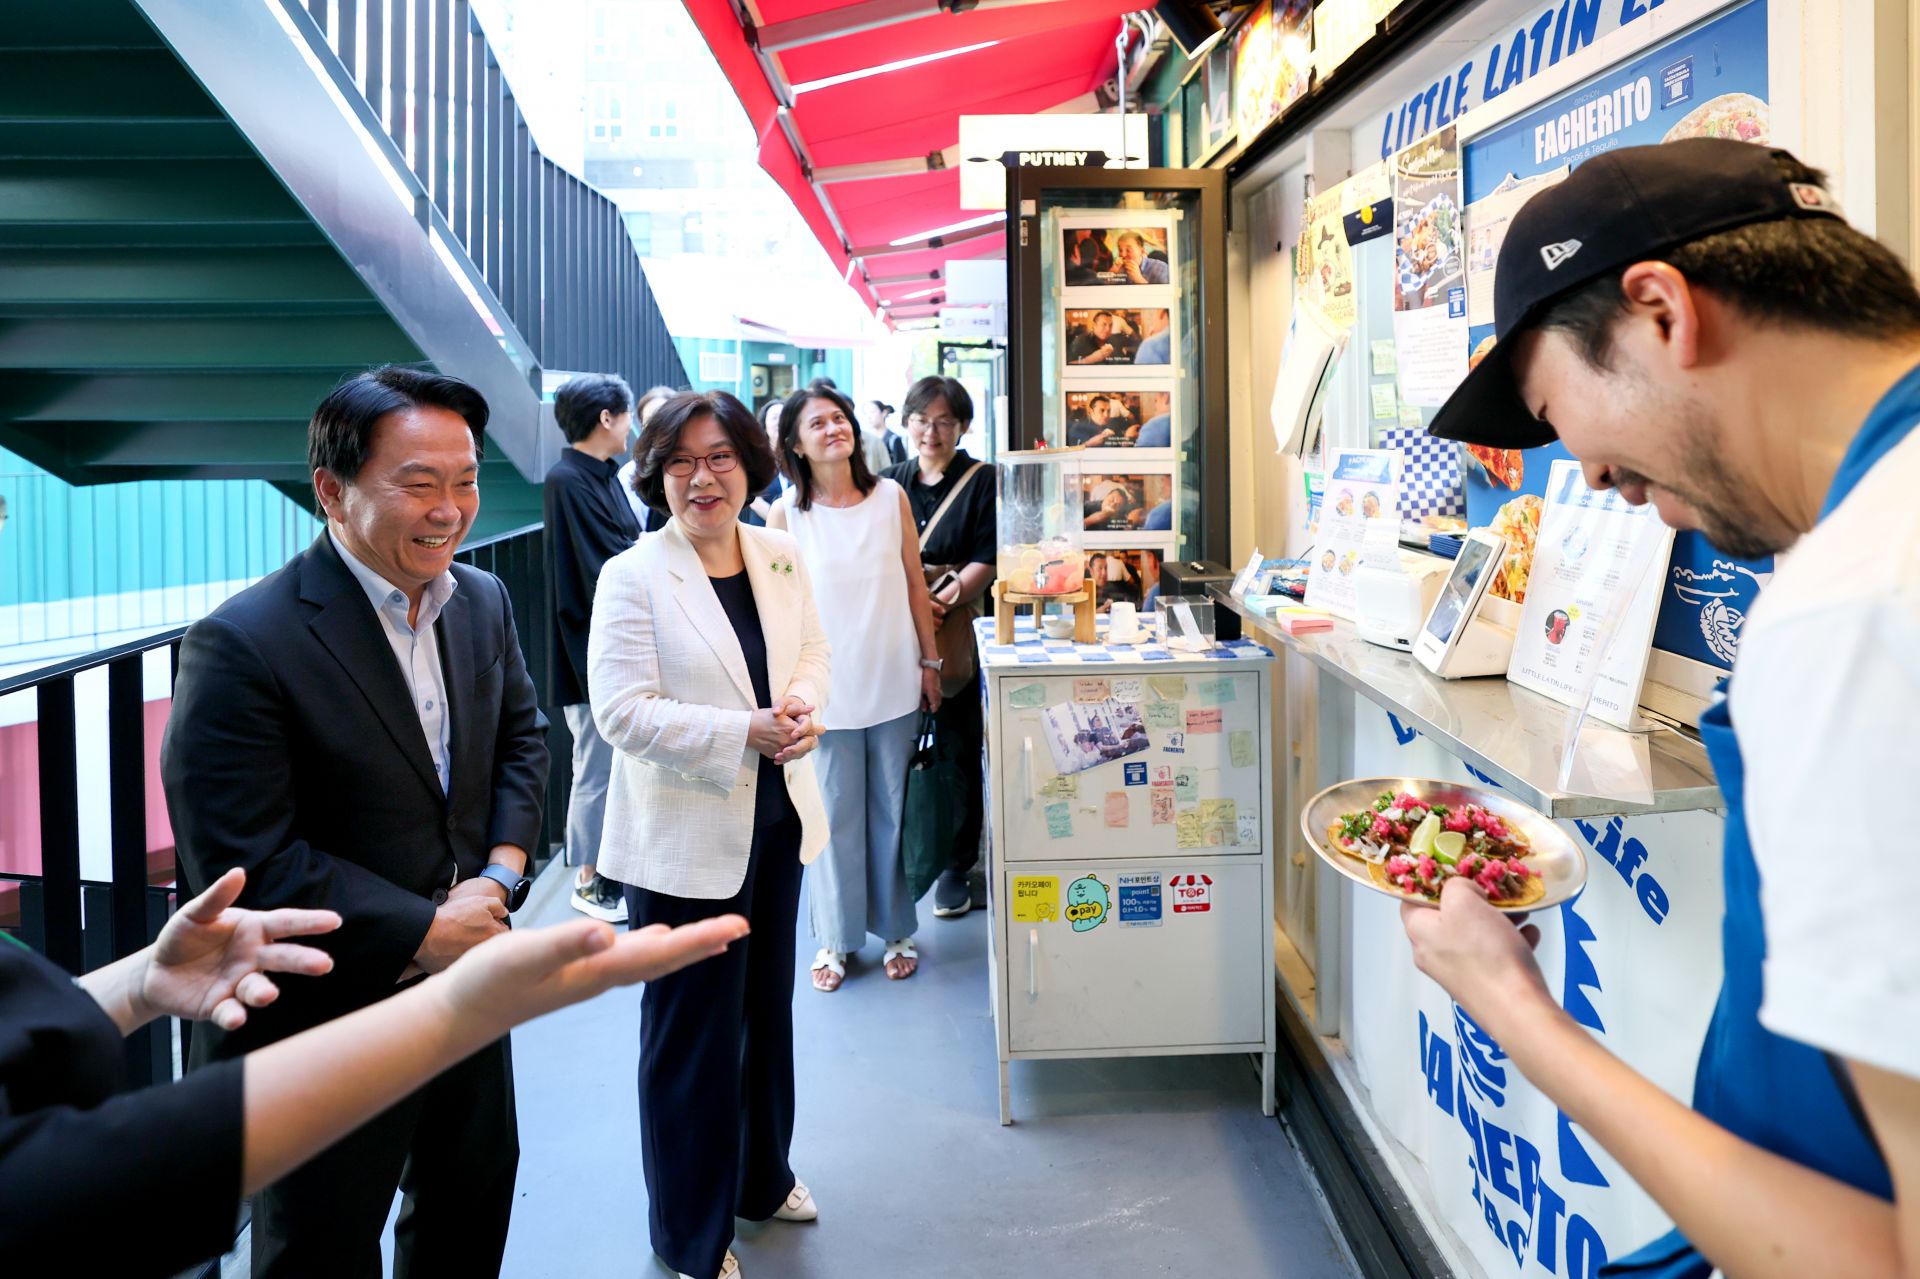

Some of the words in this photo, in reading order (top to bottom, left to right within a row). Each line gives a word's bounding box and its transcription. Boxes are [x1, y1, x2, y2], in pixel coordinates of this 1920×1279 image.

[1381, 61, 1473, 161] LITTLE
[1483, 0, 1601, 101] LATIN
[1534, 76, 1651, 165] FACHERITO
[1019, 151, 1088, 166] PUTNEY
[1562, 153, 1584, 166] Tacos
[1591, 138, 1618, 155] Tequila
[1521, 666, 1542, 680] LITTLE
[1541, 676, 1560, 688] LATIN
[1559, 682, 1574, 693] LIFE
[1017, 881, 1052, 889] 카카오페이
[1119, 876, 1134, 884] NH
[1017, 889, 1038, 898] 됩니다
[1178, 887, 1205, 898] TOP
[1079, 905, 1097, 916] pay
